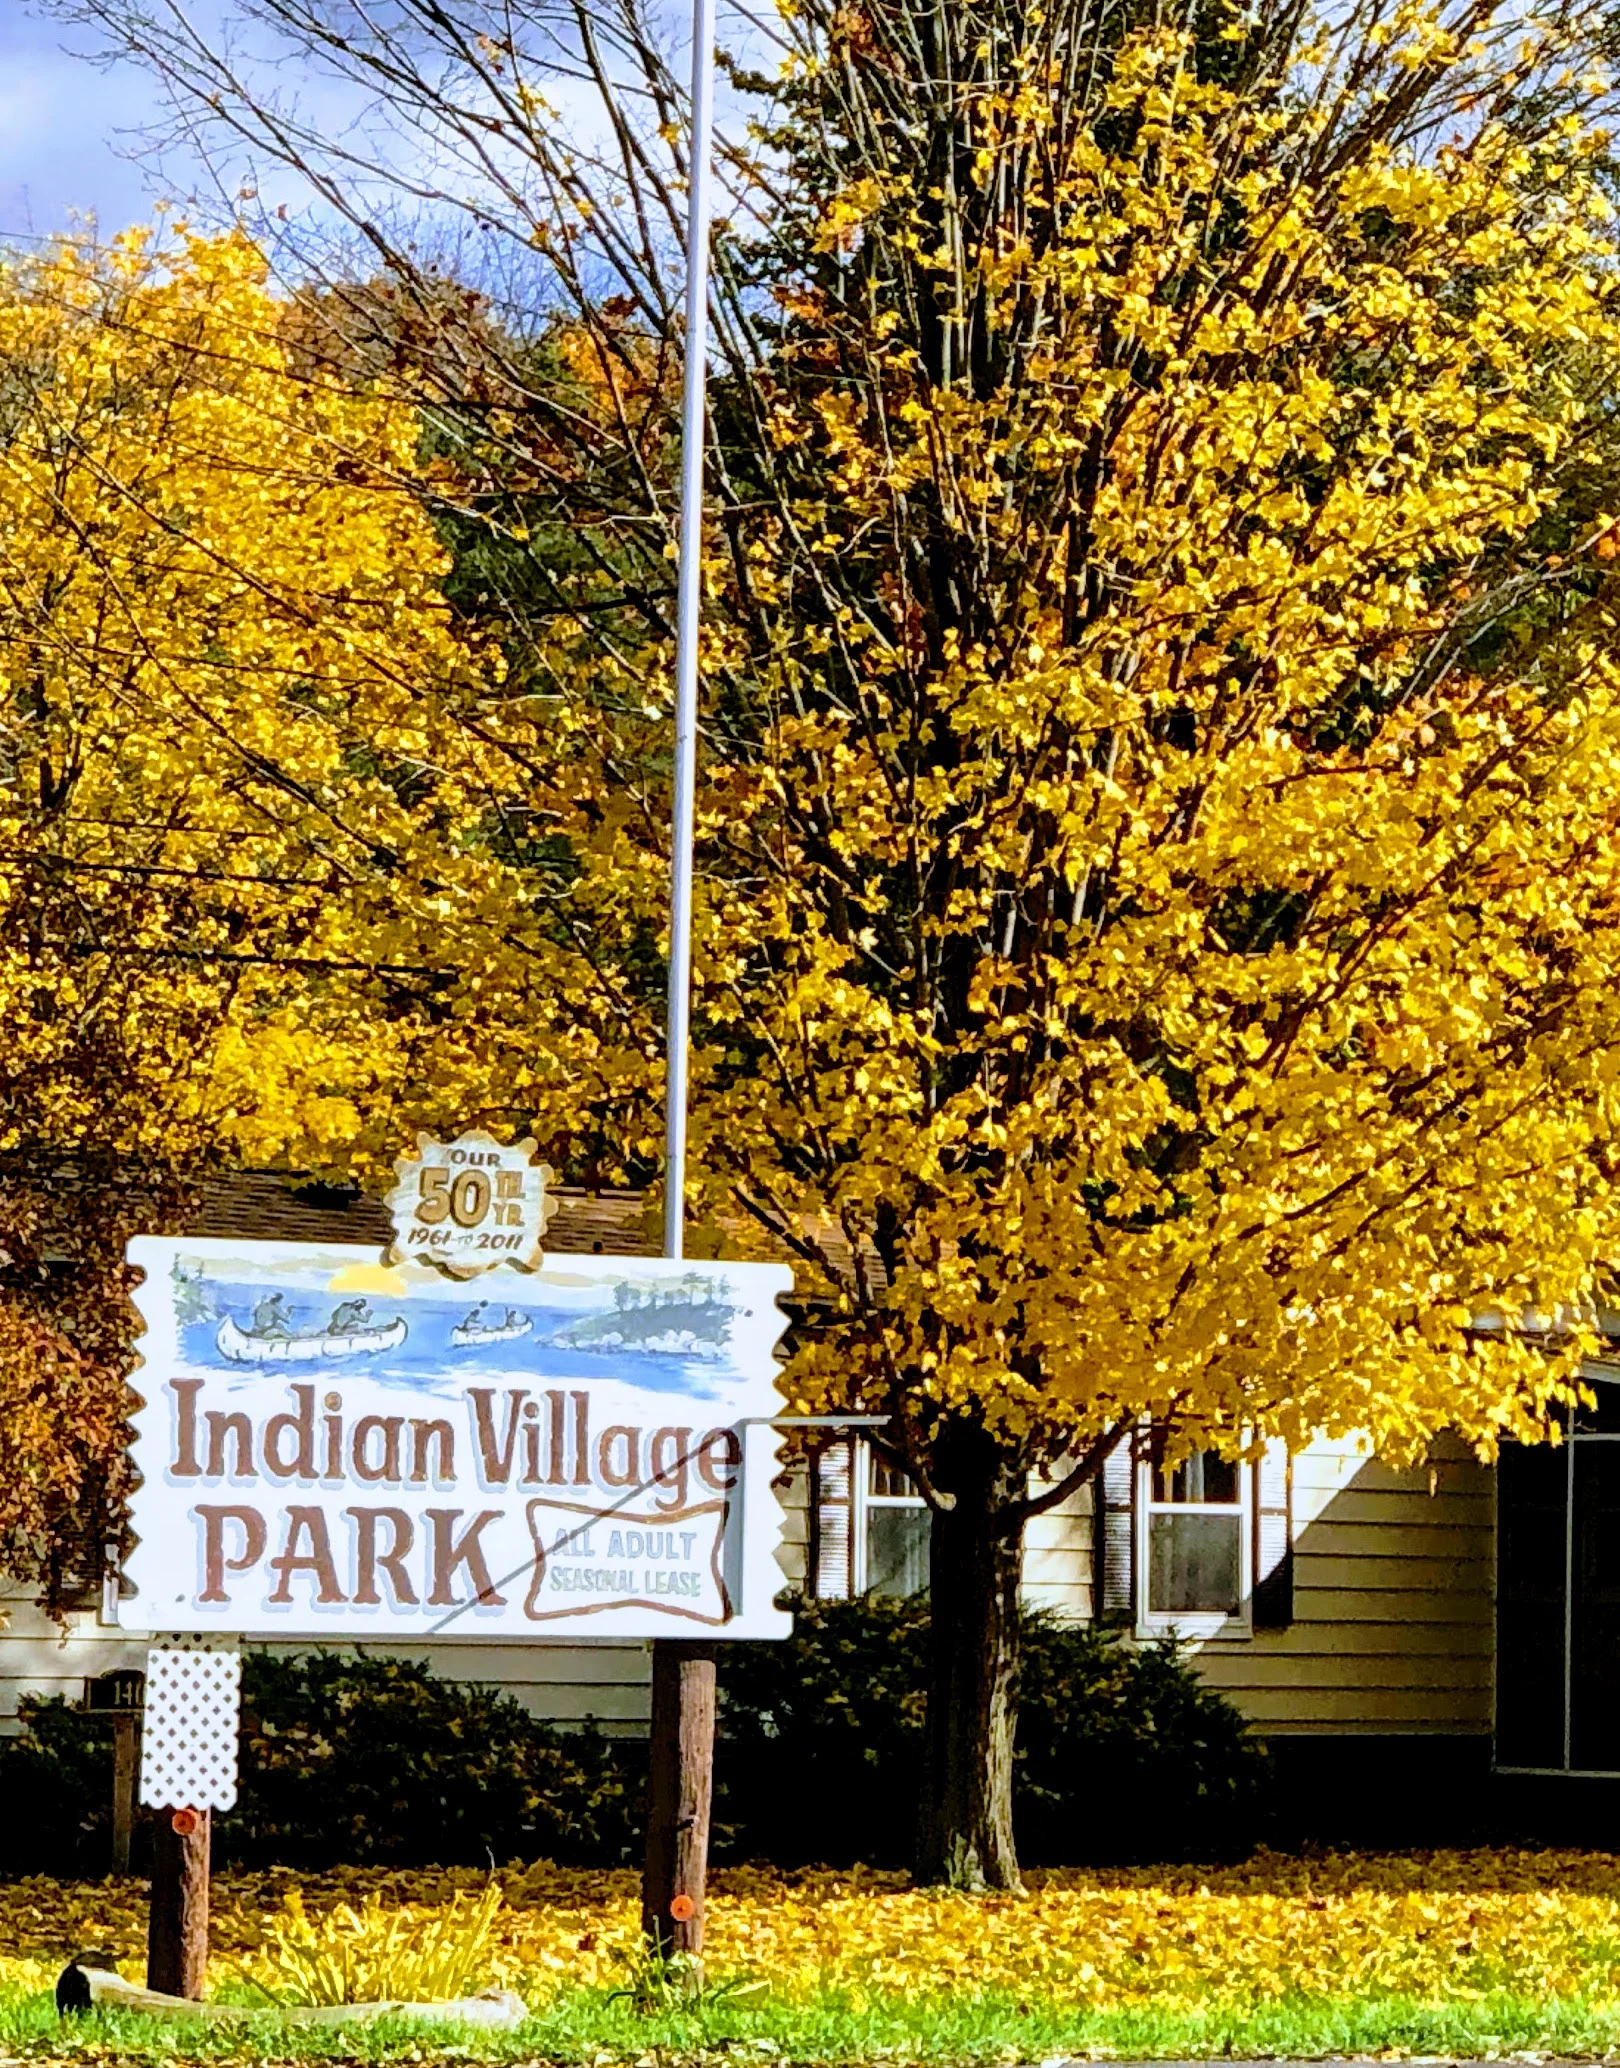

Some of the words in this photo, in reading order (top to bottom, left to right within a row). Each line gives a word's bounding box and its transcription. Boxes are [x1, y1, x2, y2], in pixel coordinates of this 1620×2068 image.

[451, 1149, 501, 1167] OUR
[414, 1167, 492, 1229] 50
[476, 1232, 525, 1251] 2011
[166, 1377, 458, 1484] Indian
[466, 1386, 744, 1512] Village
[193, 1504, 508, 1607] PARK
[551, 1527, 596, 1558] ALL
[607, 1530, 698, 1561] ADULT
[549, 1565, 640, 1595] SEASONAL
[644, 1570, 702, 1598] LEASE
